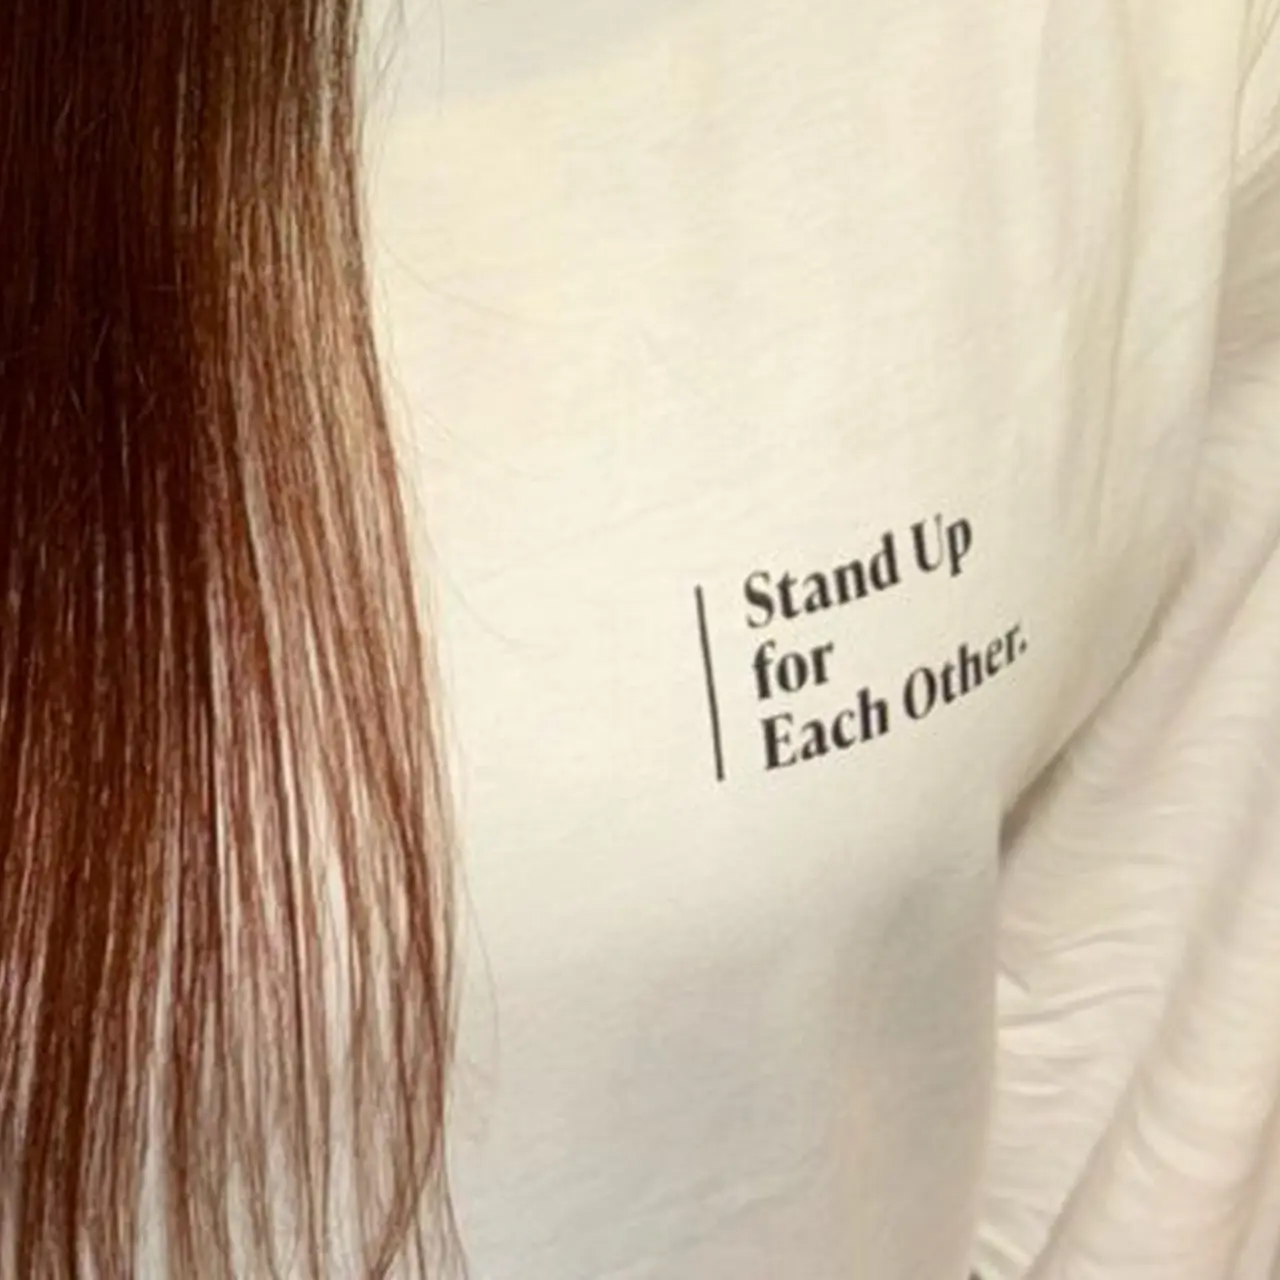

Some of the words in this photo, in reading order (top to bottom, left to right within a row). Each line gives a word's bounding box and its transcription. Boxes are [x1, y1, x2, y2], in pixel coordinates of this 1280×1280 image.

[743, 531, 901, 628] Stand
[910, 513, 973, 577] Up
[752, 639, 834, 700] for
[760, 687, 889, 770] Each
[903, 624, 1027, 720] Other.
